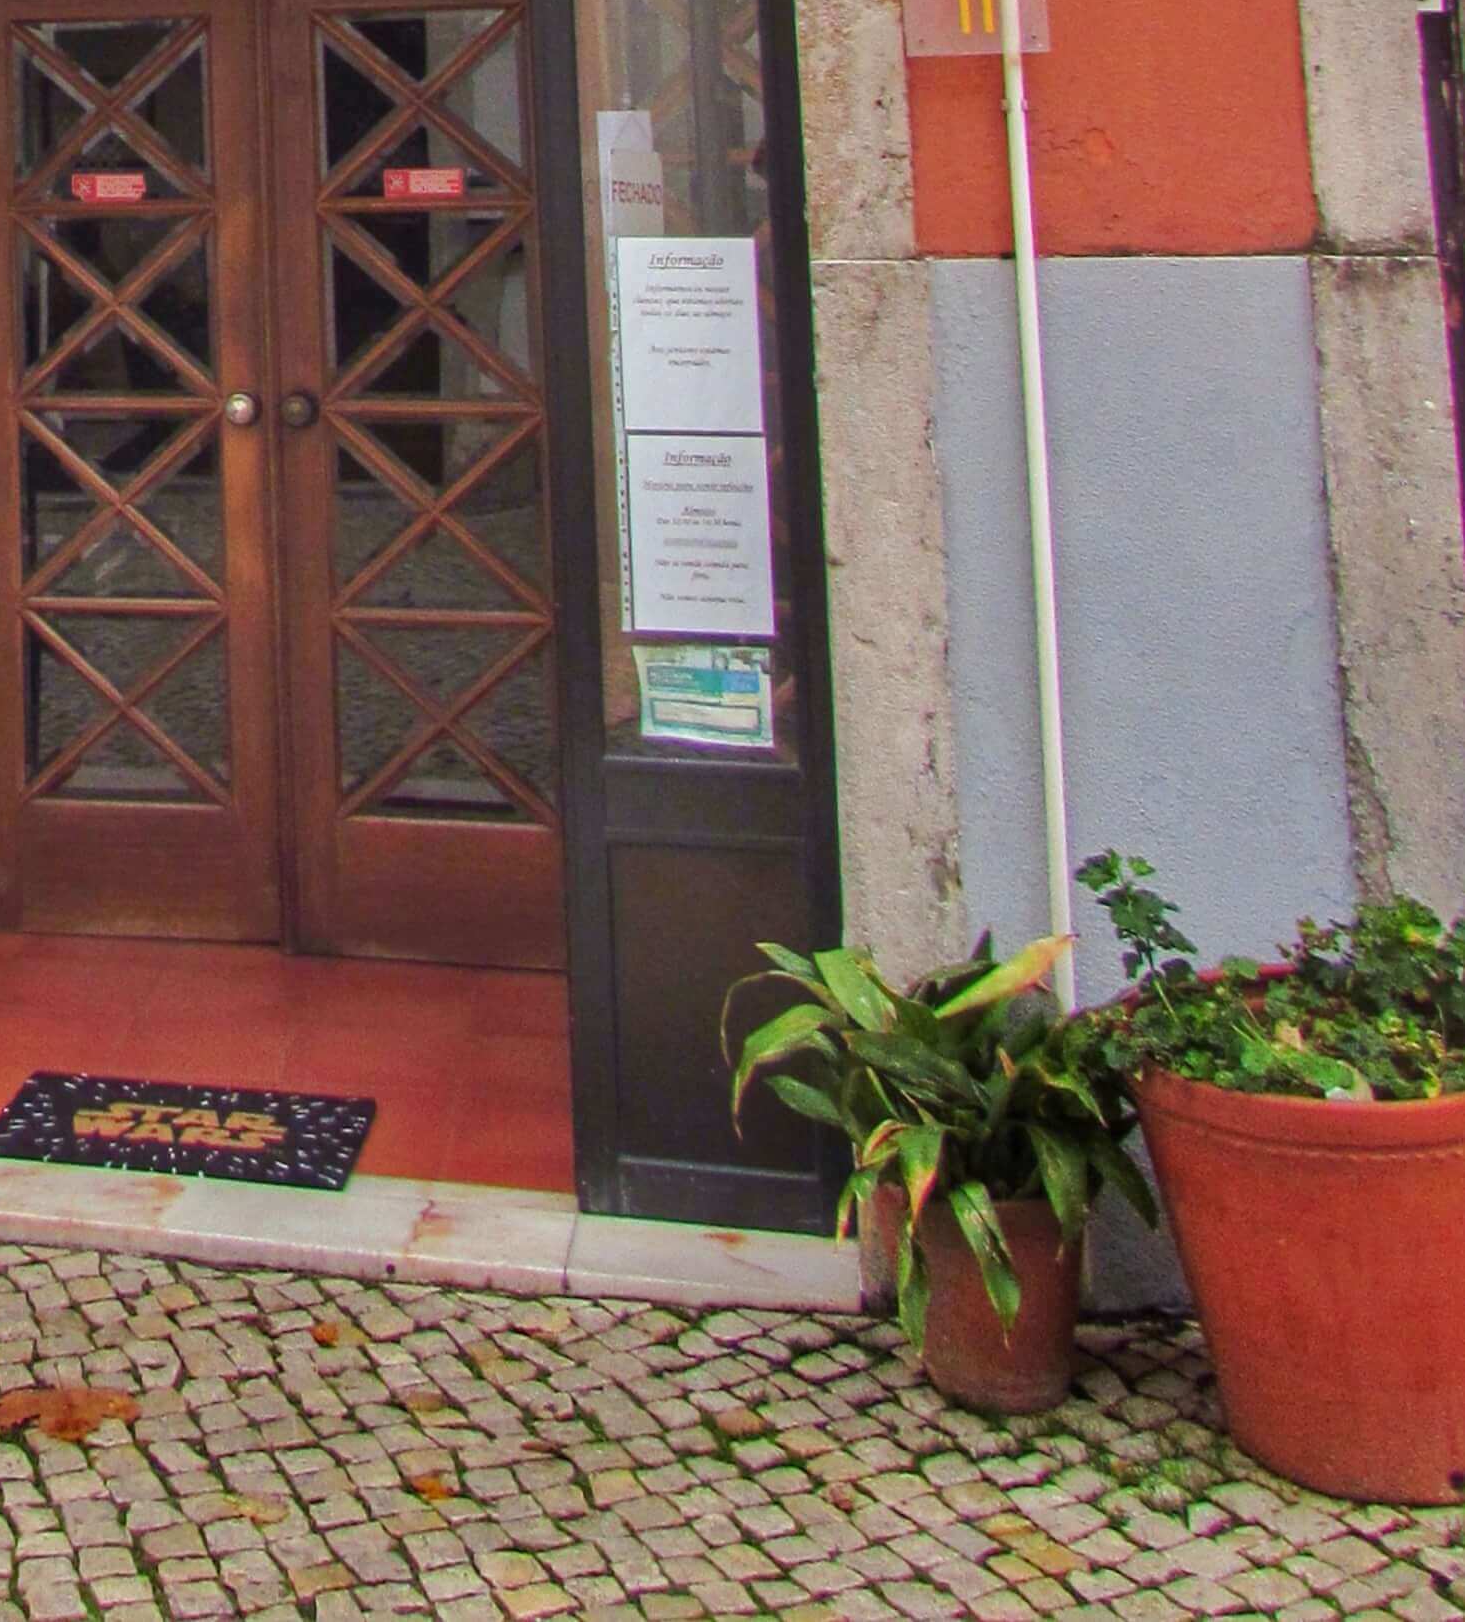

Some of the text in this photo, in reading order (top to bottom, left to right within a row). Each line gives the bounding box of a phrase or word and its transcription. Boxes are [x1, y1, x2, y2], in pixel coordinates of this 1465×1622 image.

[612, 180, 662, 205] FECHADO
[648, 251, 725, 270] Informação
[76, 1102, 287, 1132] STAR
[73, 1114, 284, 1150] WARS
